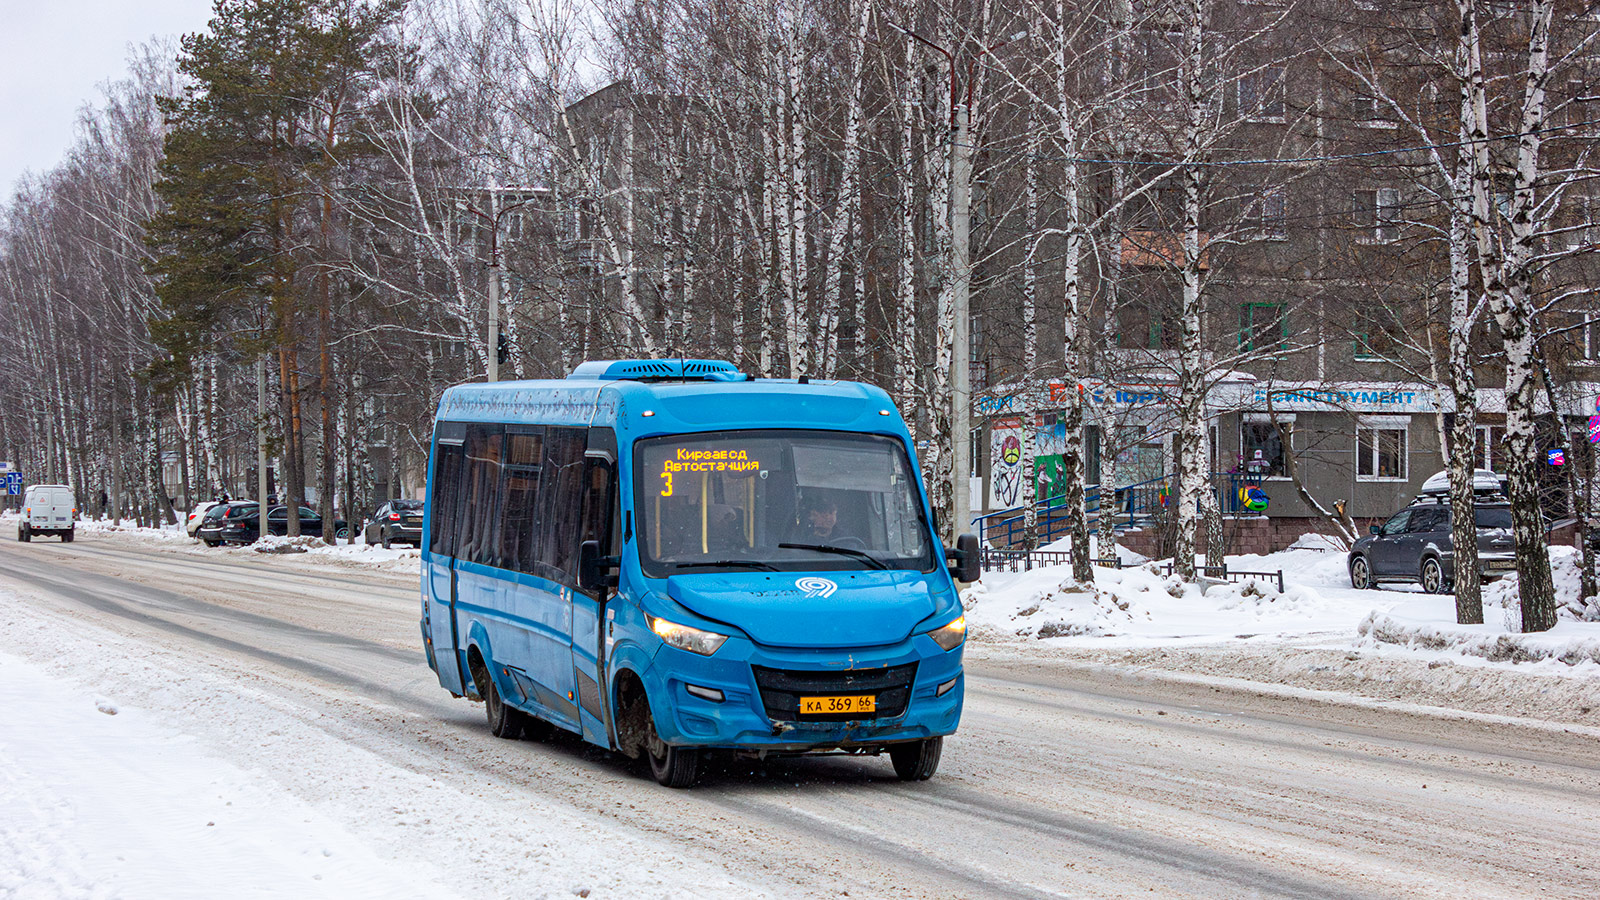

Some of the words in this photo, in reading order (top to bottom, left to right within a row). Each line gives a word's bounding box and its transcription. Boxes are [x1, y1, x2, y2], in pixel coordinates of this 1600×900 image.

[660, 472, 673, 497] 3
[806, 701, 823, 712] КА
[828, 698, 852, 711] 369
[858, 697, 871, 707] 66
